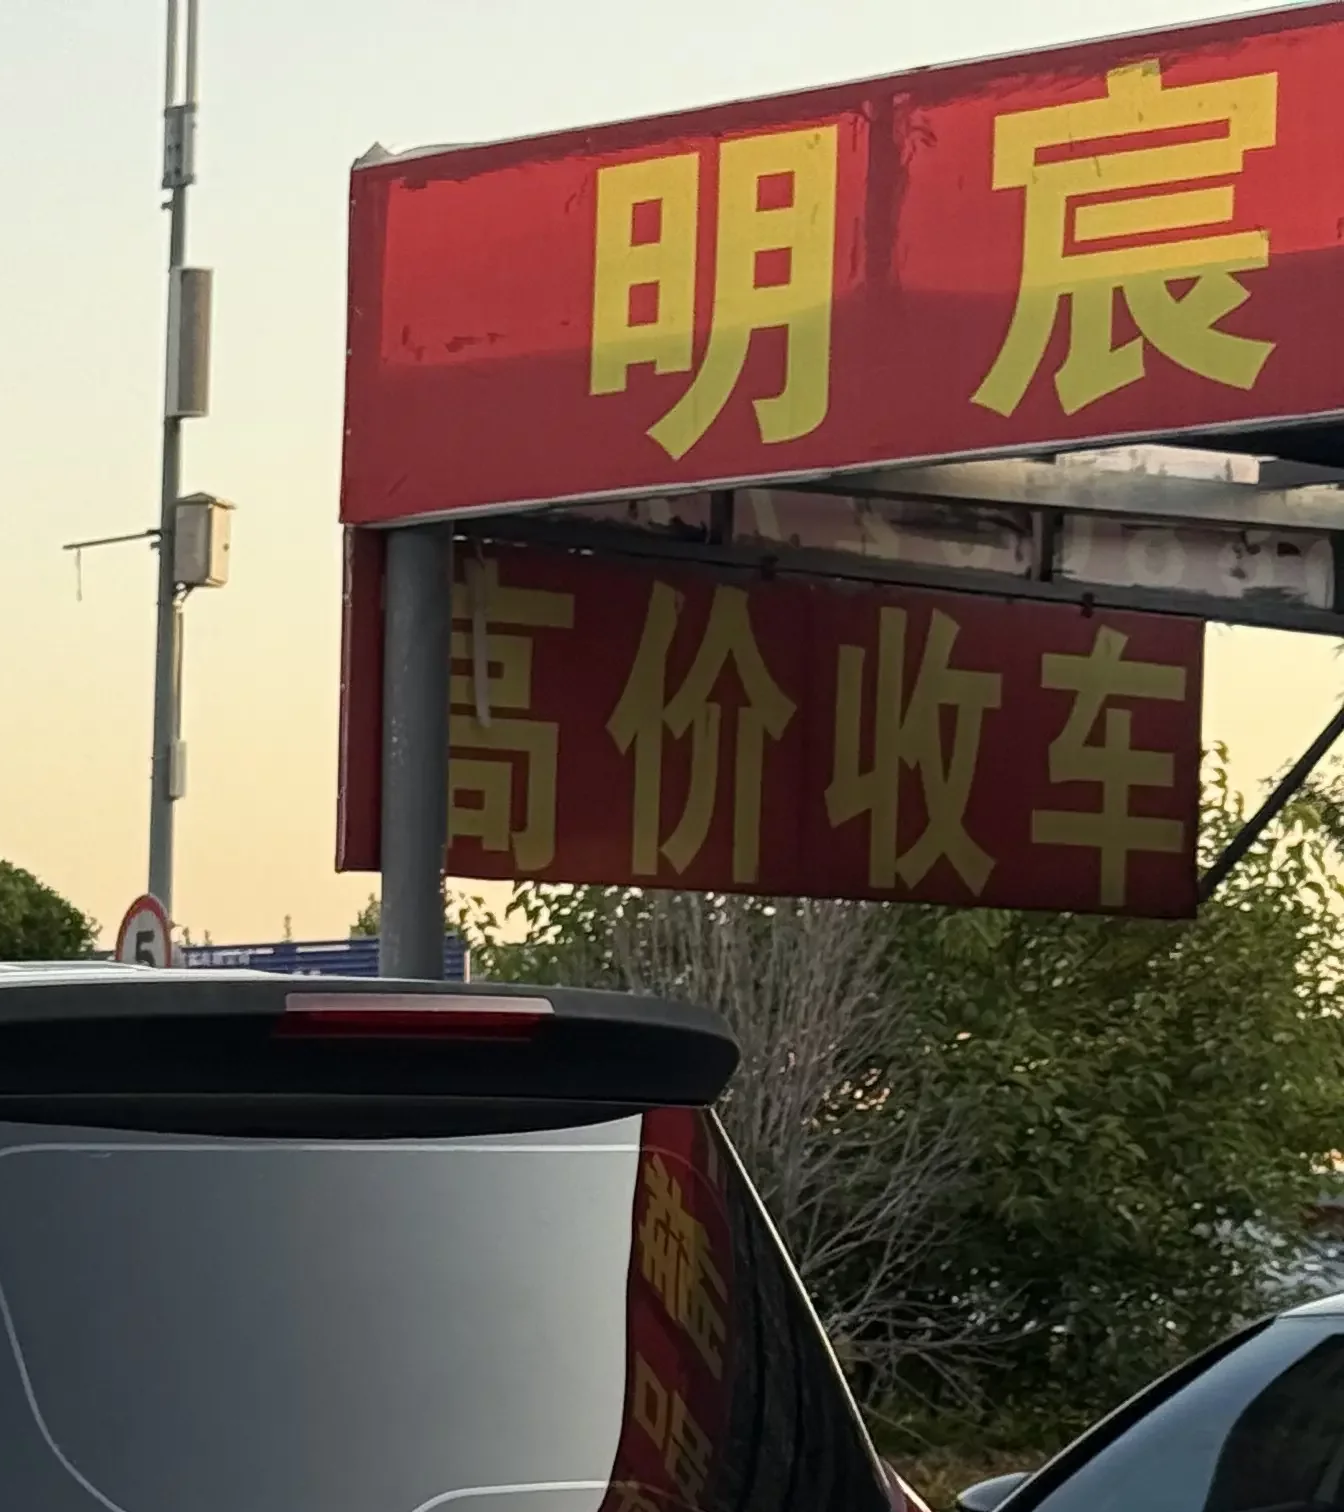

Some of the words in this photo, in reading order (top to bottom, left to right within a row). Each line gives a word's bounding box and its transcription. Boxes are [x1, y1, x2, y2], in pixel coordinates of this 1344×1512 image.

[590, 58, 1279, 463] 明宸
[447, 557, 1188, 907] 高价收车
[135, 930, 156, 967] 5
